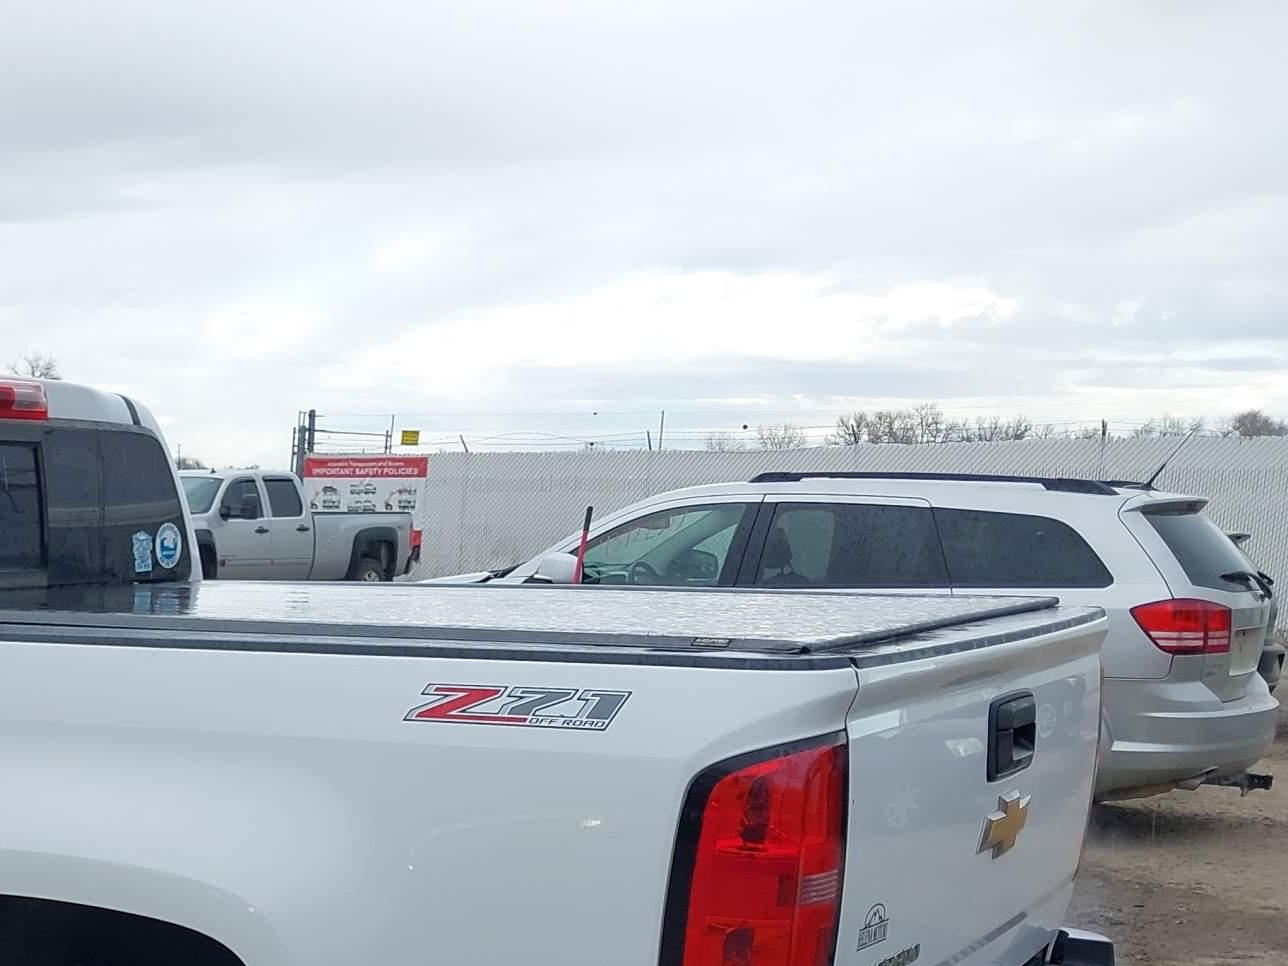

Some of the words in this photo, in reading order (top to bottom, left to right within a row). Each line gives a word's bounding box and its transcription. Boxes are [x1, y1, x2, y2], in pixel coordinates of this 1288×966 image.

[354, 467, 382, 475] SAFETY
[383, 467, 418, 475] POLICIES
[403, 683, 632, 728] Z71
[528, 717, 561, 726] OFF
[561, 719, 606, 728] ROAD
